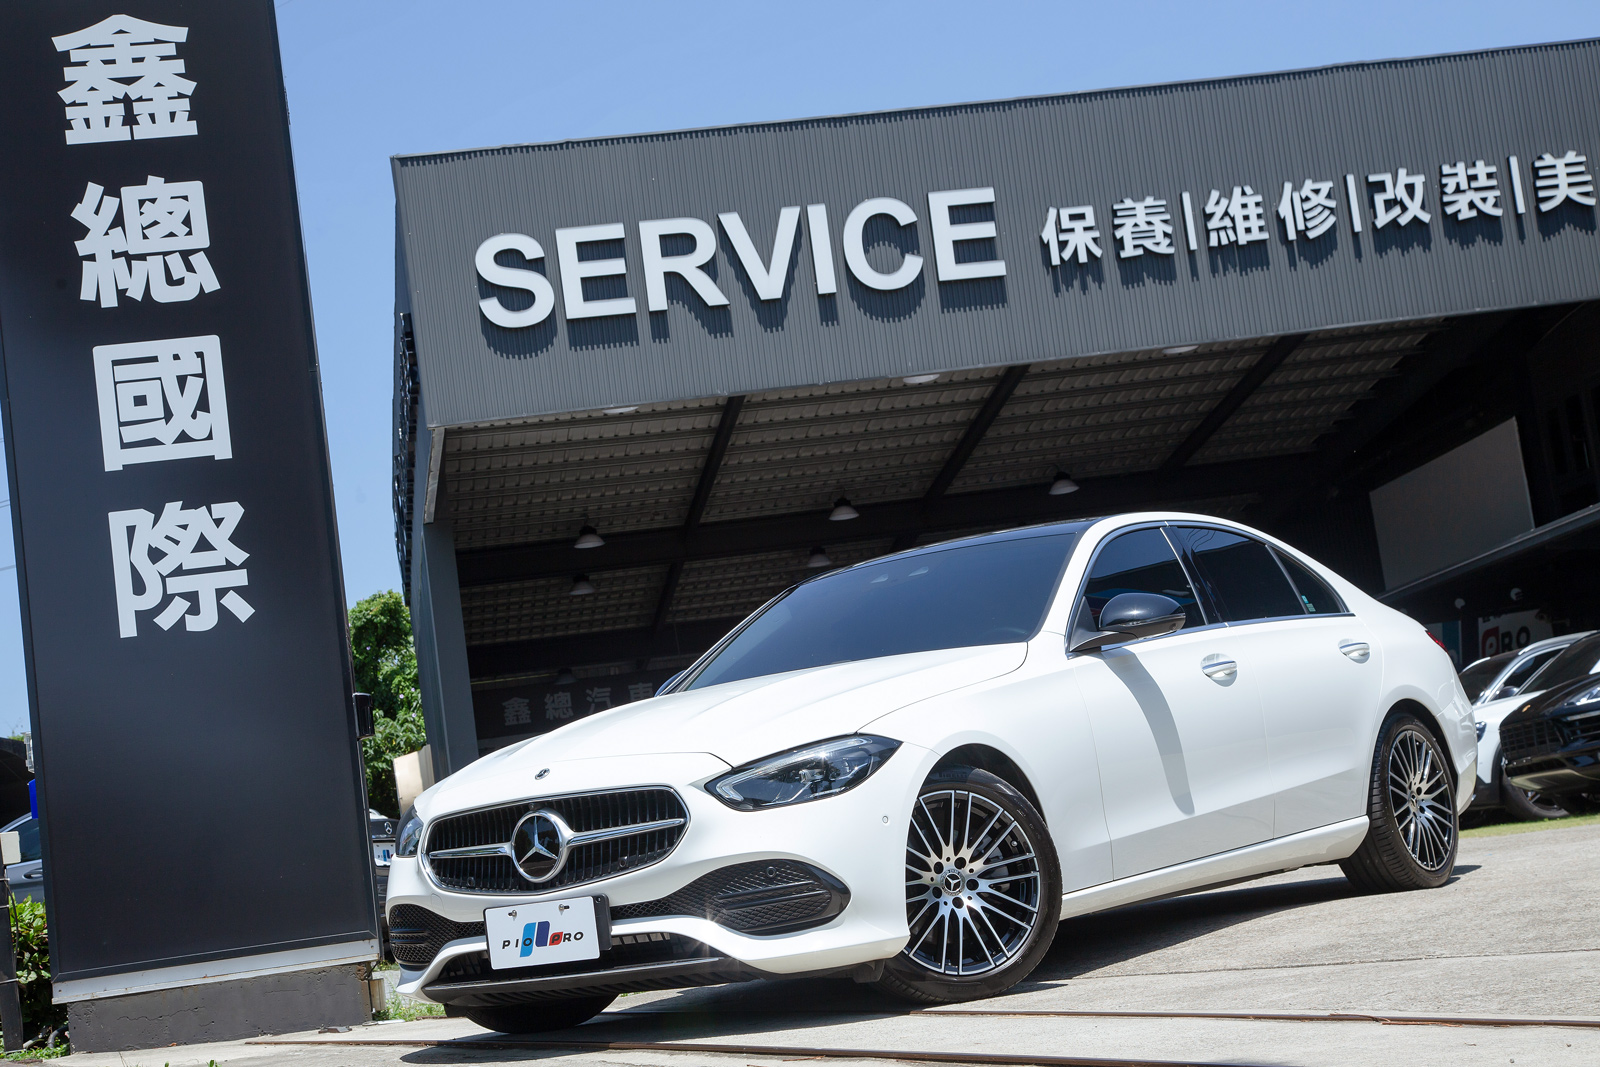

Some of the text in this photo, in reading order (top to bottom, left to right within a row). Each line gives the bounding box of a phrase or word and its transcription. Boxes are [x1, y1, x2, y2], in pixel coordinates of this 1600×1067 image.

[51, 13, 256, 639] 鑫總國際
[474, 186, 1007, 329] SERVICE
